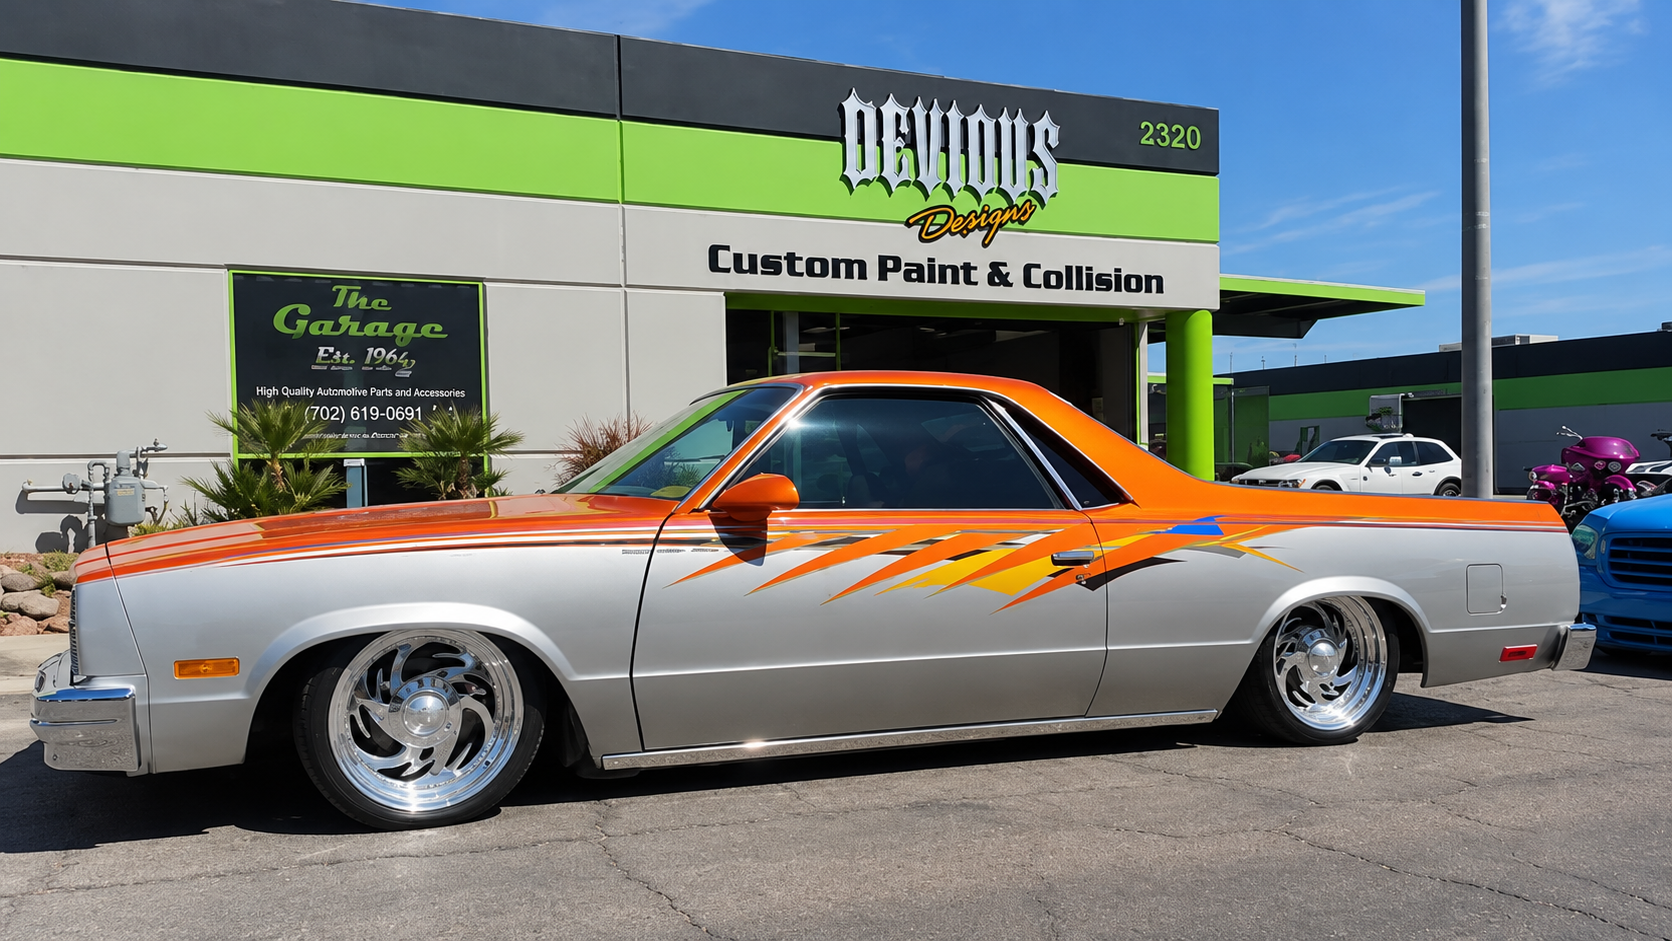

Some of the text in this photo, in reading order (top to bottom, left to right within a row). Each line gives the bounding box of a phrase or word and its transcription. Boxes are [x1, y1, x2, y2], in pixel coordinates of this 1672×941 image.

[839, 87, 1061, 206] DEVIOUS
[1139, 121, 1202, 150] 2320
[905, 199, 1038, 248] Designs
[708, 244, 1165, 294] Custom Paint & Collision
[331, 285, 392, 311] The
[273, 303, 449, 347] Garage
[315, 346, 355, 364] Est.
[256, 386, 466, 398] High Quality Automotive Parts and Accessories
[304, 405, 422, 424] (702) 619-0691
